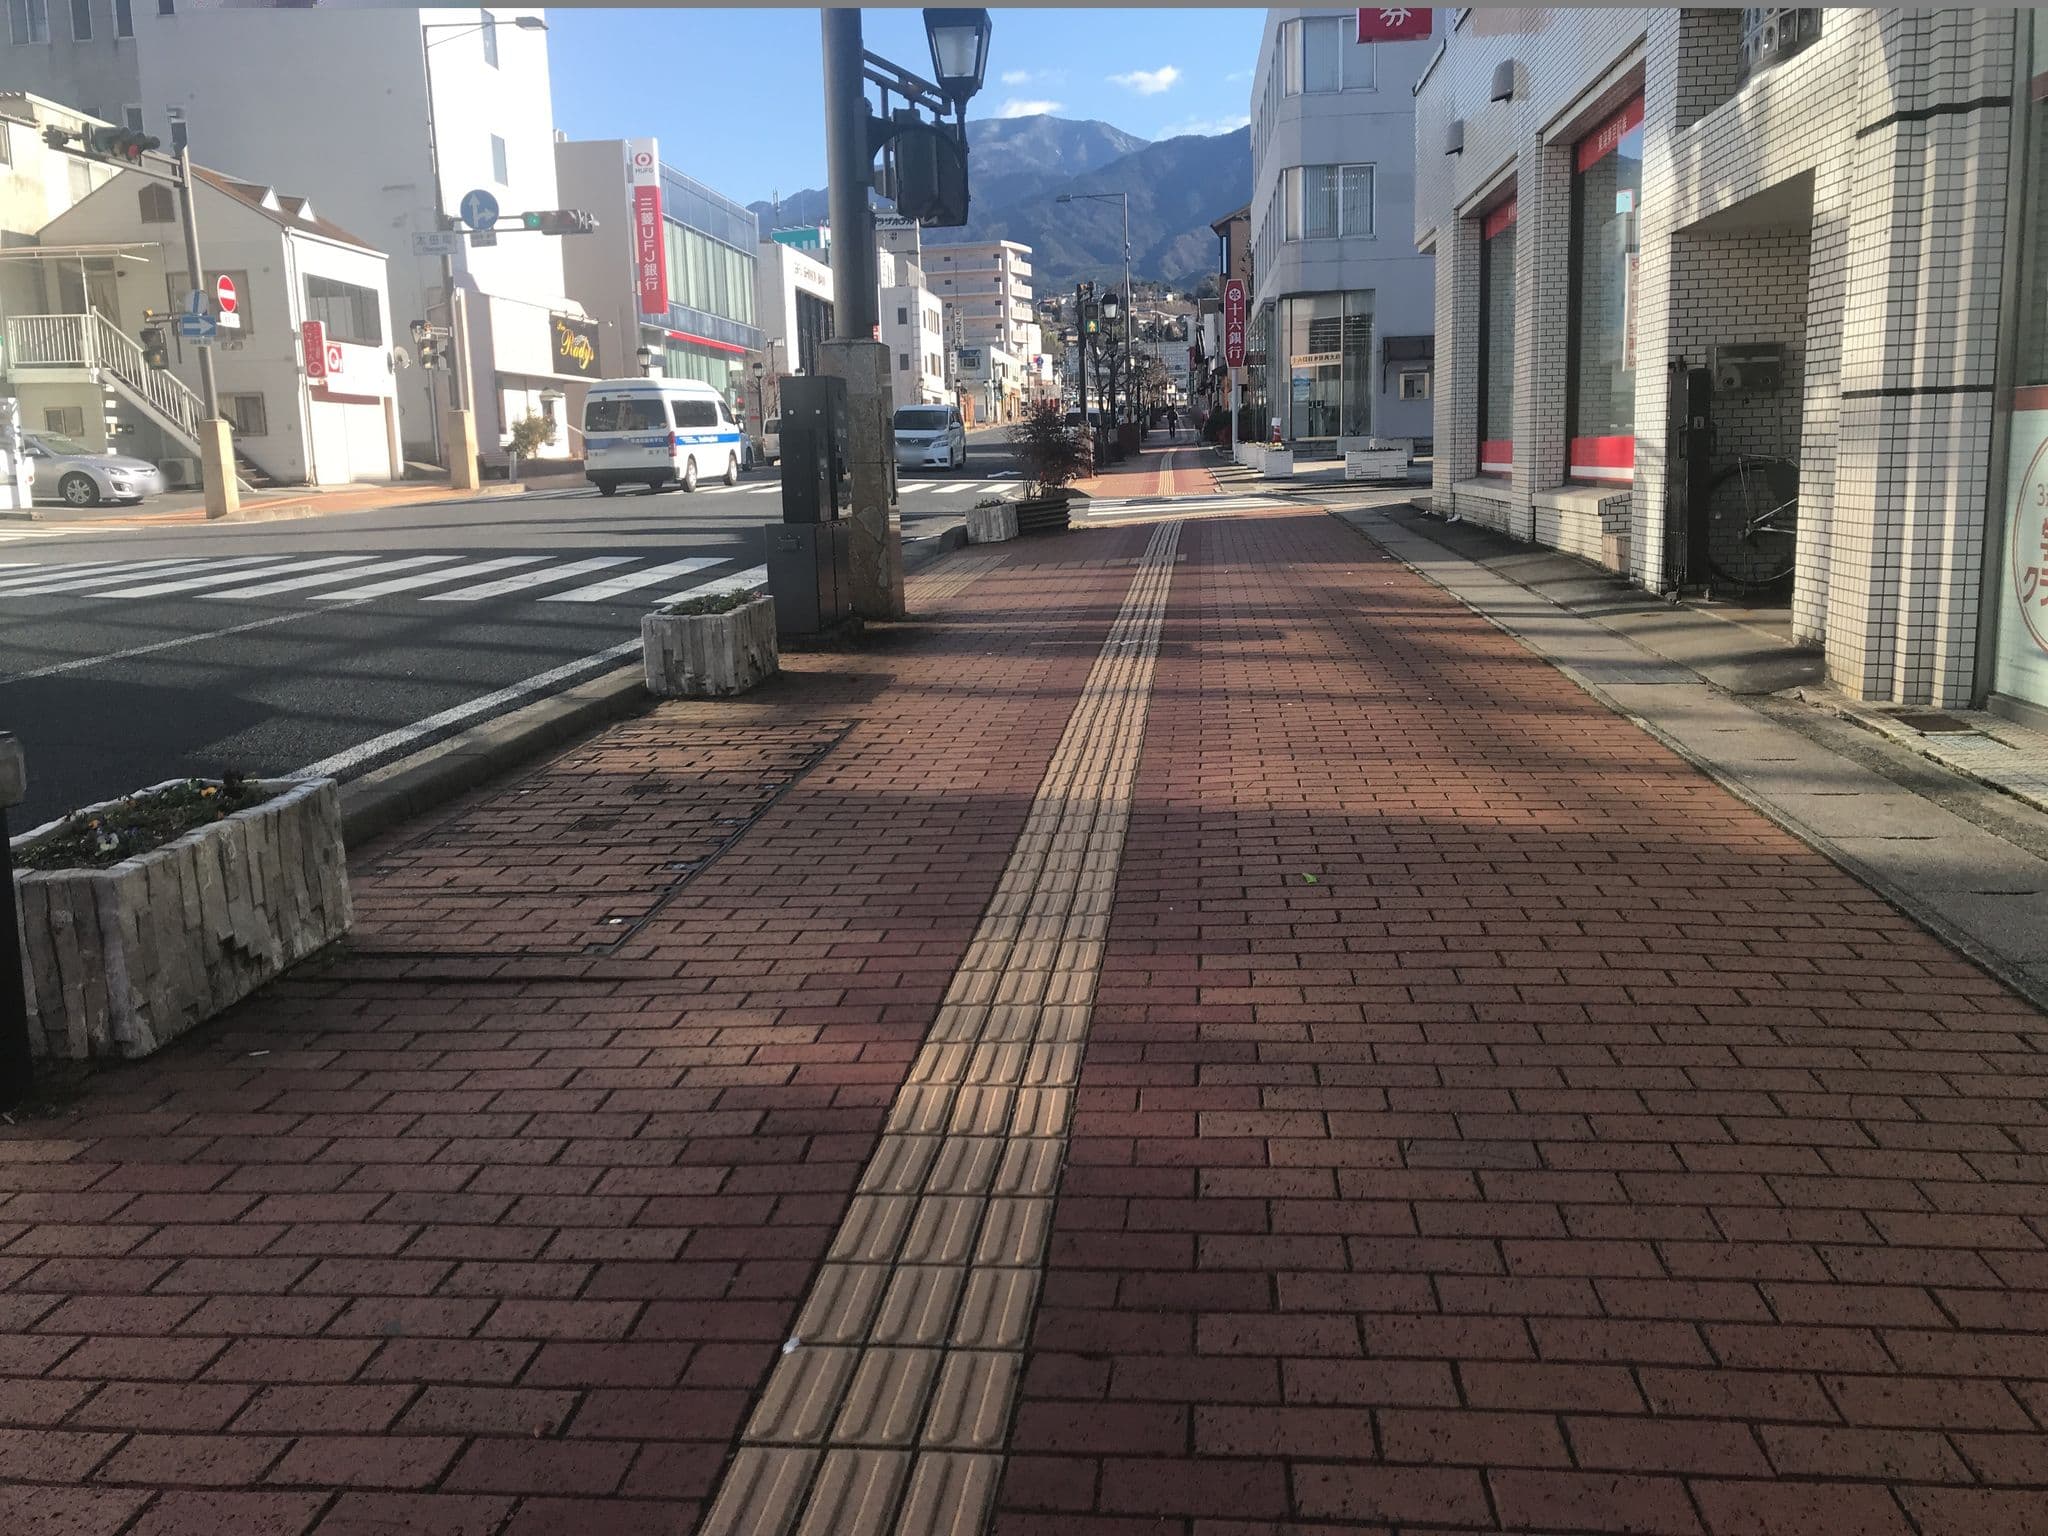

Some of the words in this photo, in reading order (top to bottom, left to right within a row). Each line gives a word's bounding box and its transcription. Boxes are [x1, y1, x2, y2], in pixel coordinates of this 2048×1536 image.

[640, 197, 658, 291] 三菱UFJ銀行
[1228, 302, 1242, 359] 十六銀行
